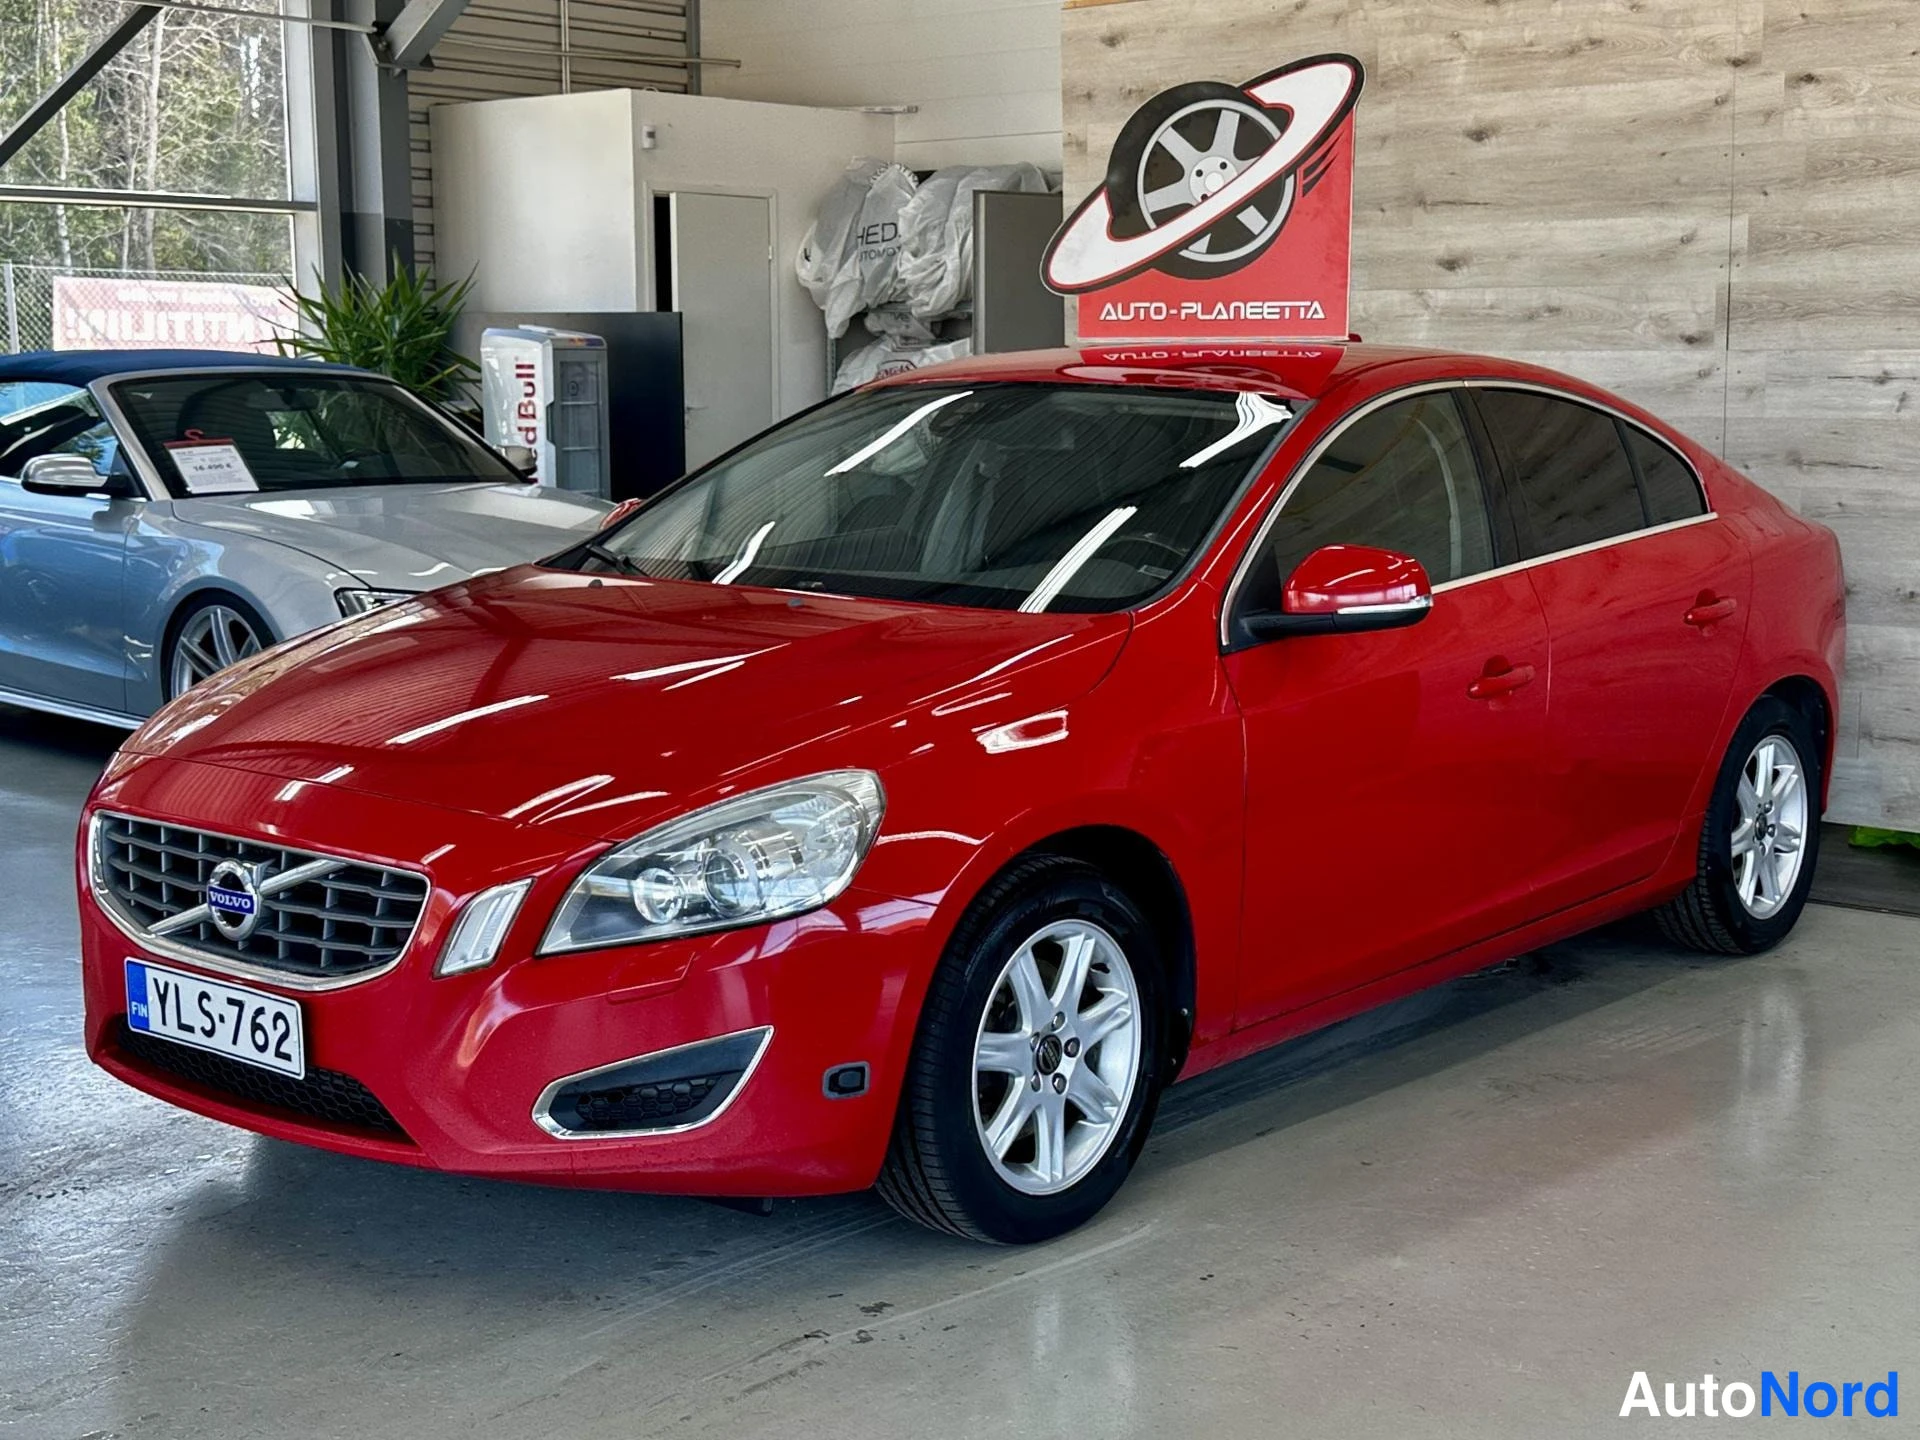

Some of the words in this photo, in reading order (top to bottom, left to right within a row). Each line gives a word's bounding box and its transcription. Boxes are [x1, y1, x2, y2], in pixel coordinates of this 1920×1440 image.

[1099, 300, 1326, 321] AUTO-PLANEETTA
[515, 364, 537, 419] Bull
[209, 891, 251, 908] VOLVO
[131, 1001, 148, 1018] FIN
[153, 977, 292, 1062] YLS-762
